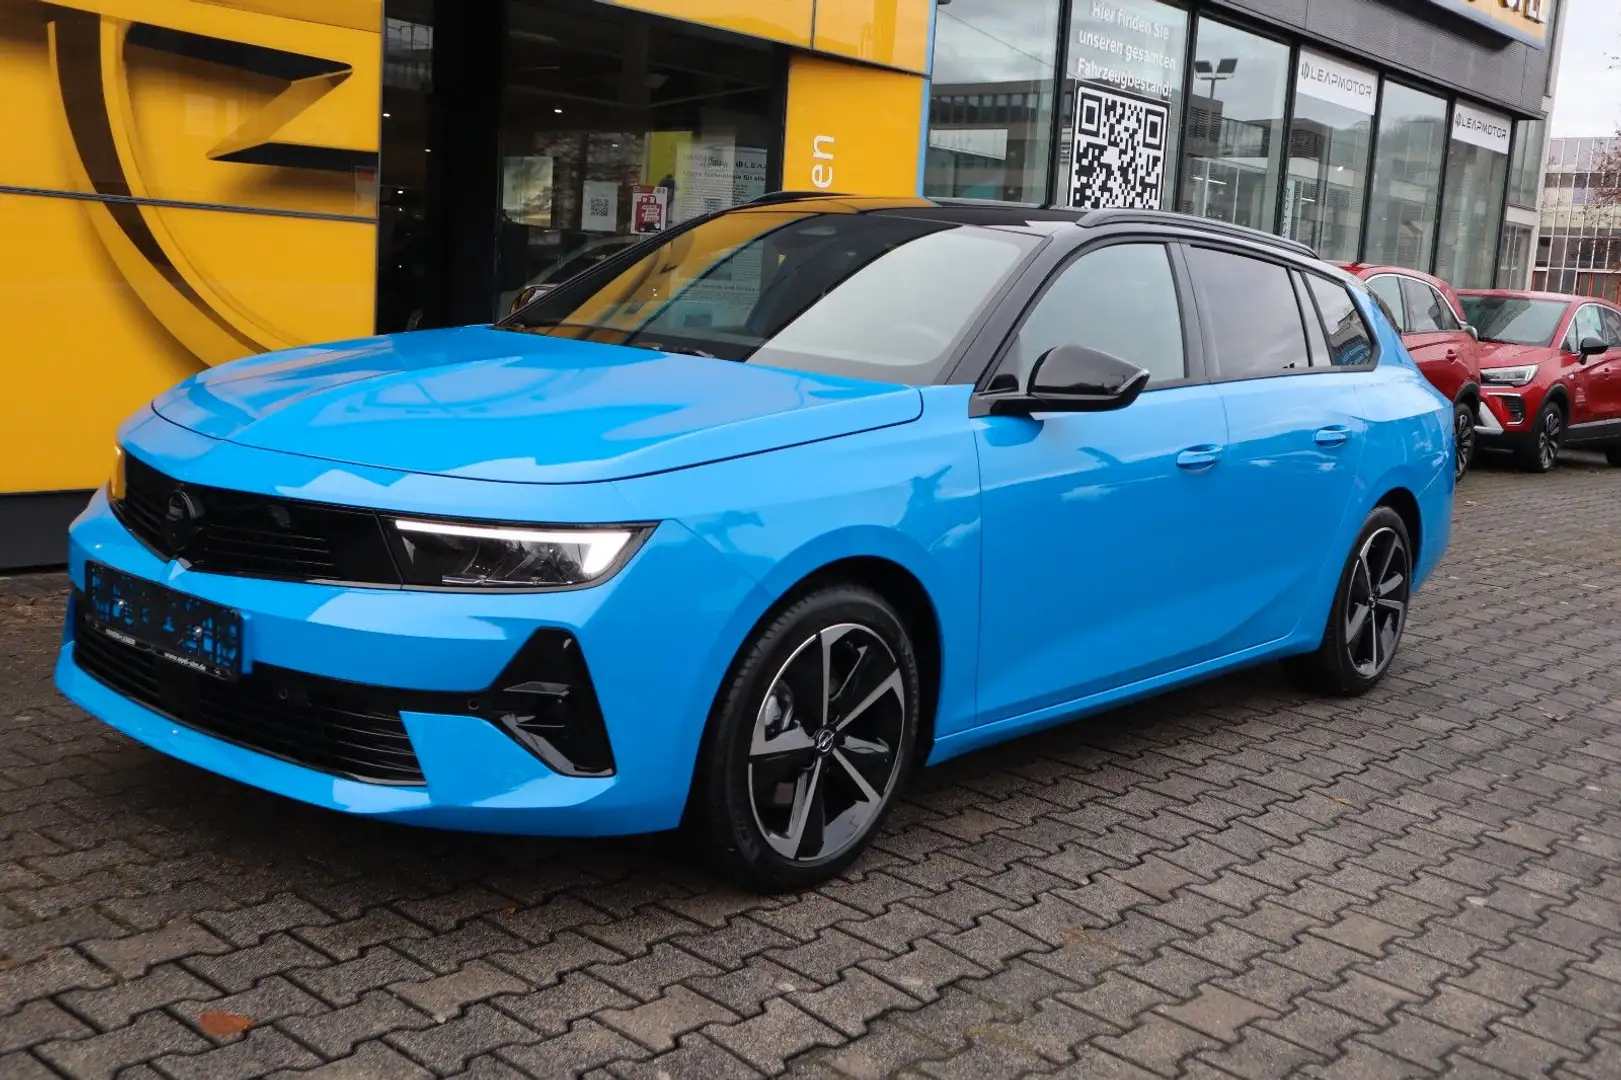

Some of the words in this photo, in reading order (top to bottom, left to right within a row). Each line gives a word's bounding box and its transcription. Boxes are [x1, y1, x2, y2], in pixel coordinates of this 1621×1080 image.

[1092, 2, 1115, 23] Hier
[1118, 8, 1151, 35] finden
[1153, 22, 1170, 40] Sie
[1079, 30, 1122, 55] unseren
[1125, 44, 1176, 70] gesamten
[1078, 57, 1173, 97] Fahrzeugbestand!
[1310, 67, 1372, 99] LEAPMOTOR
[1461, 118, 1507, 140] LEAPMOTOR
[811, 135, 835, 188] en
